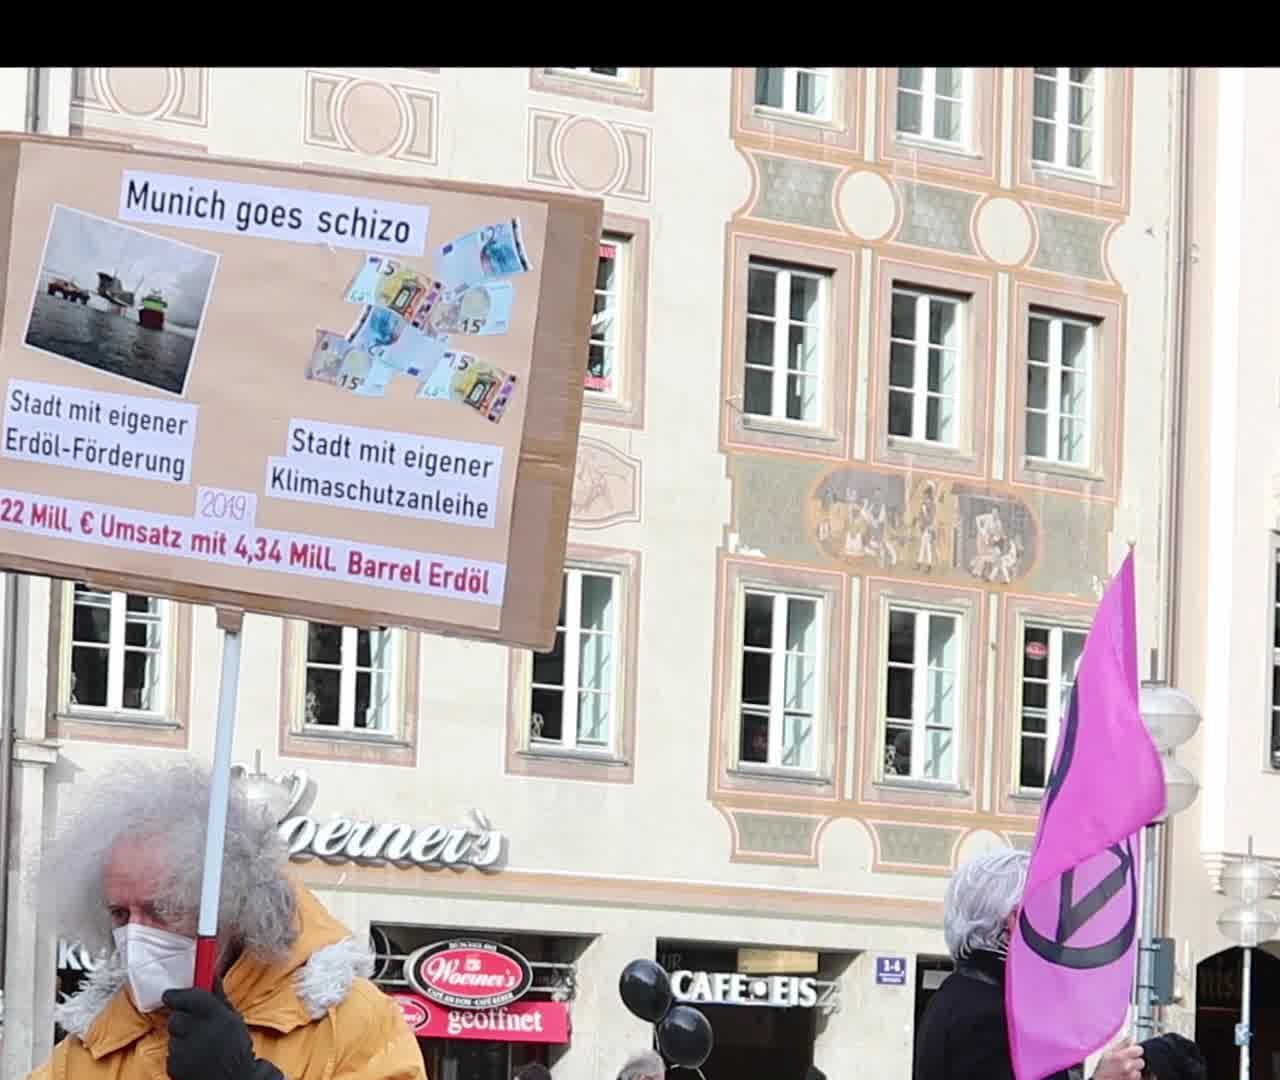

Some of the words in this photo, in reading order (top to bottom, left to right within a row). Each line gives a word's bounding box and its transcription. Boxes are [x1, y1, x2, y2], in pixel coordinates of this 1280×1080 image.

[126, 179, 225, 221] Munich
[235, 200, 303, 231] goes
[317, 207, 411, 243] schizo
[10, 389, 61, 418] Stadt
[69, 400, 101, 424] mit
[108, 405, 189, 436] eigener
[5, 427, 185, 482] Erdöl-Förderung
[291, 428, 351, 459] Stadt
[359, 440, 396, 466] mit
[404, 446, 494, 478] eigener
[201, 490, 247, 520] 2019
[271, 467, 489, 519] Klimaschutzanleihe
[30, 503, 72, 533] Mill.
[79, 511, 95, 535] €
[101, 515, 182, 548] Umsatz
[191, 530, 227, 555] mit
[234, 534, 282, 565] 4,34
[289, 541, 337, 572] Mill.
[347, 550, 421, 584] Barrel
[428, 562, 489, 595] Erdöl
[773, 976, 818, 1007] EIS
